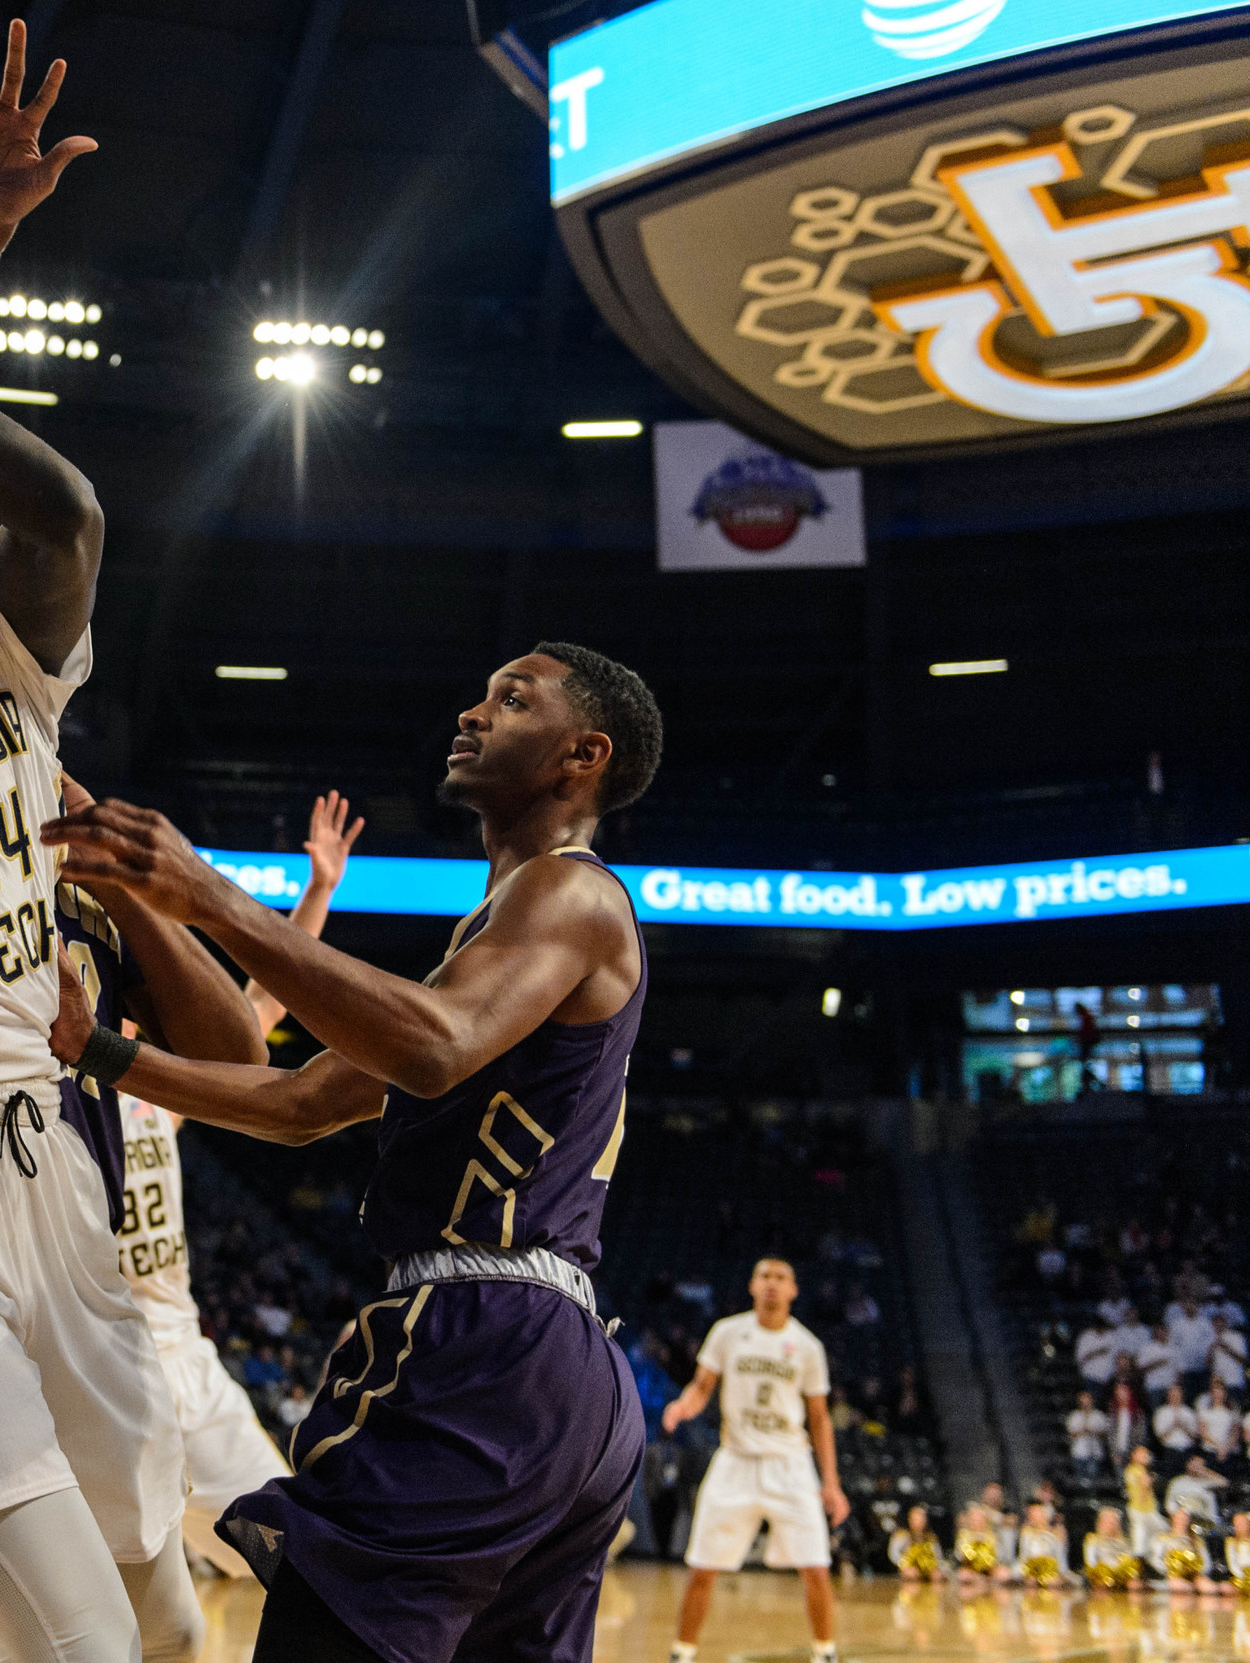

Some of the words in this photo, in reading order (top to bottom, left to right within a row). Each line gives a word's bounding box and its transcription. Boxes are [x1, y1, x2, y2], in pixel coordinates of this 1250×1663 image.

[640, 868, 772, 913] Great
[779, 872, 893, 917] food.
[900, 873, 1007, 916] Low
[1013, 861, 1188, 918] prices.
